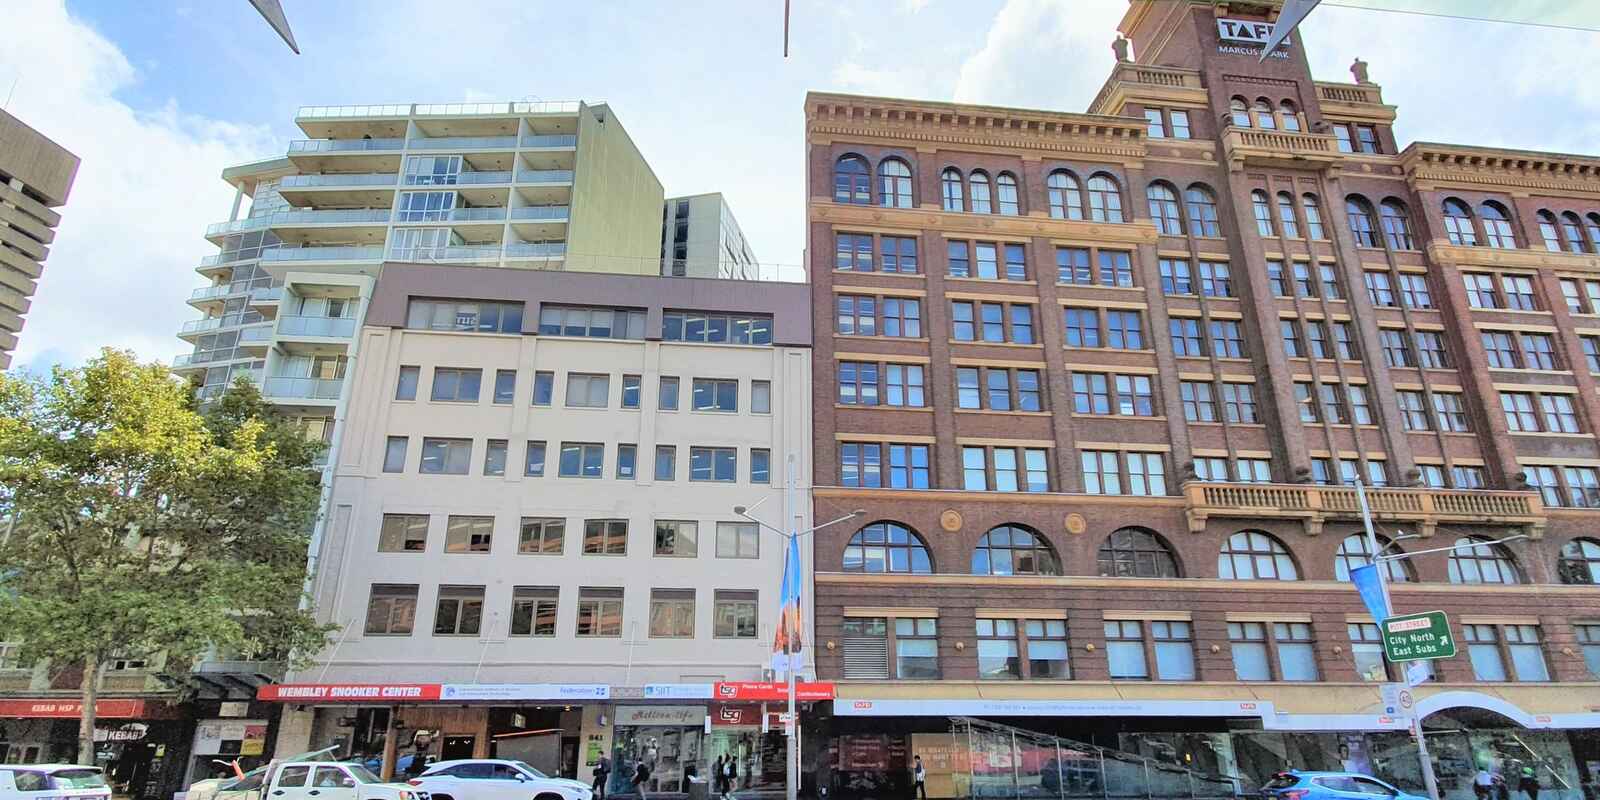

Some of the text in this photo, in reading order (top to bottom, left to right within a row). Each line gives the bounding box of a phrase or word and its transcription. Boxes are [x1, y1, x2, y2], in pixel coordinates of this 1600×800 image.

[1218, 46, 1258, 56] MARCUS
[1389, 632, 1436, 646] City North
[1393, 645, 1437, 656] East Subs
[277, 687, 421, 697] WEMBLEY SNOOKER CENTER
